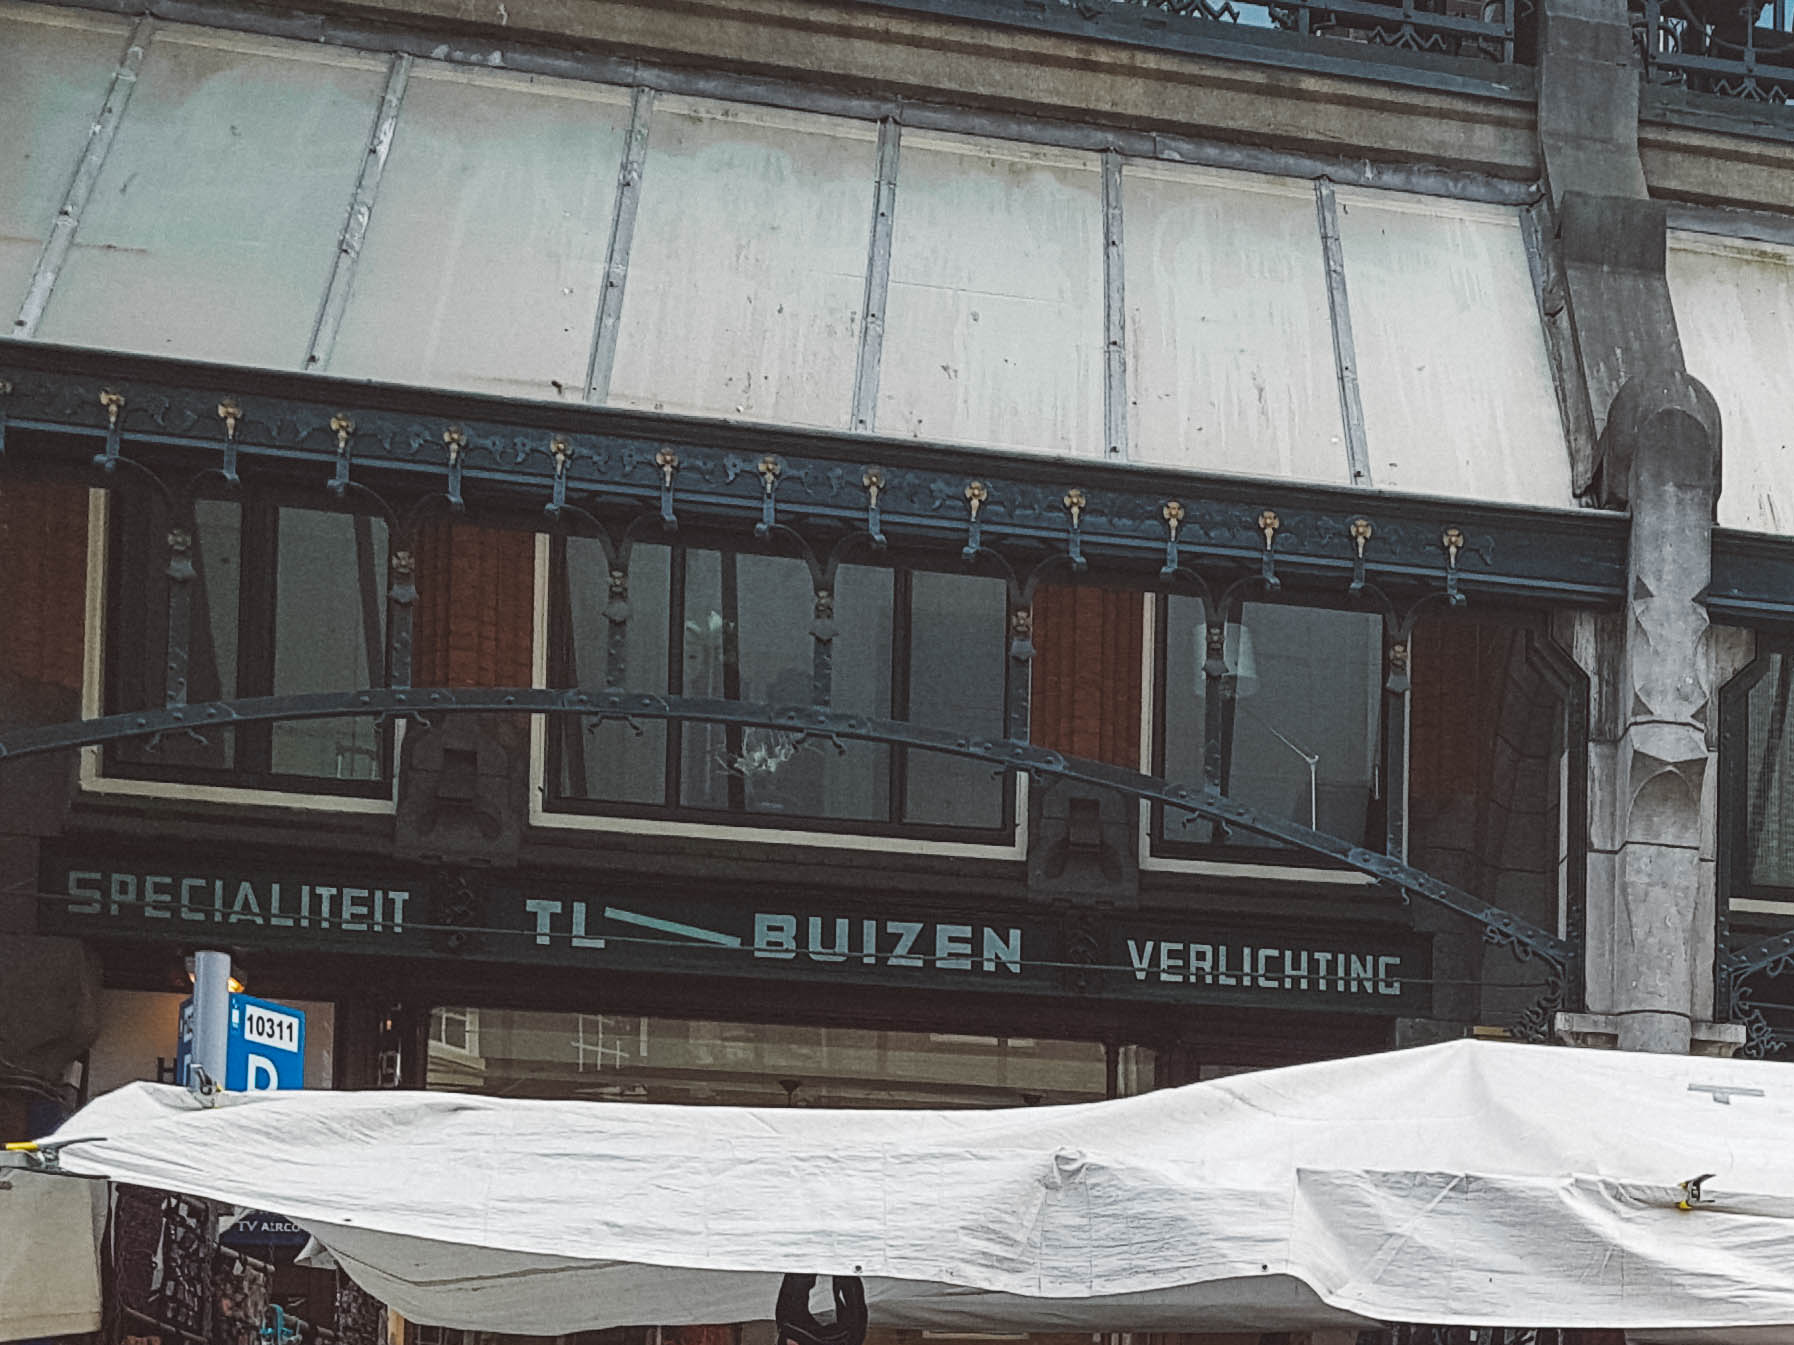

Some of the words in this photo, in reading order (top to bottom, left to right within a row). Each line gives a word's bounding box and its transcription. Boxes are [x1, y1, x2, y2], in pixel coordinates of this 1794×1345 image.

[67, 870, 409, 933] SPECIALITEIT
[754, 913, 1021, 973] BUIZEN
[1127, 940, 1400, 995] VERLICHTING
[247, 1014, 293, 1042] 10311
[238, 1221, 258, 1232] TV
